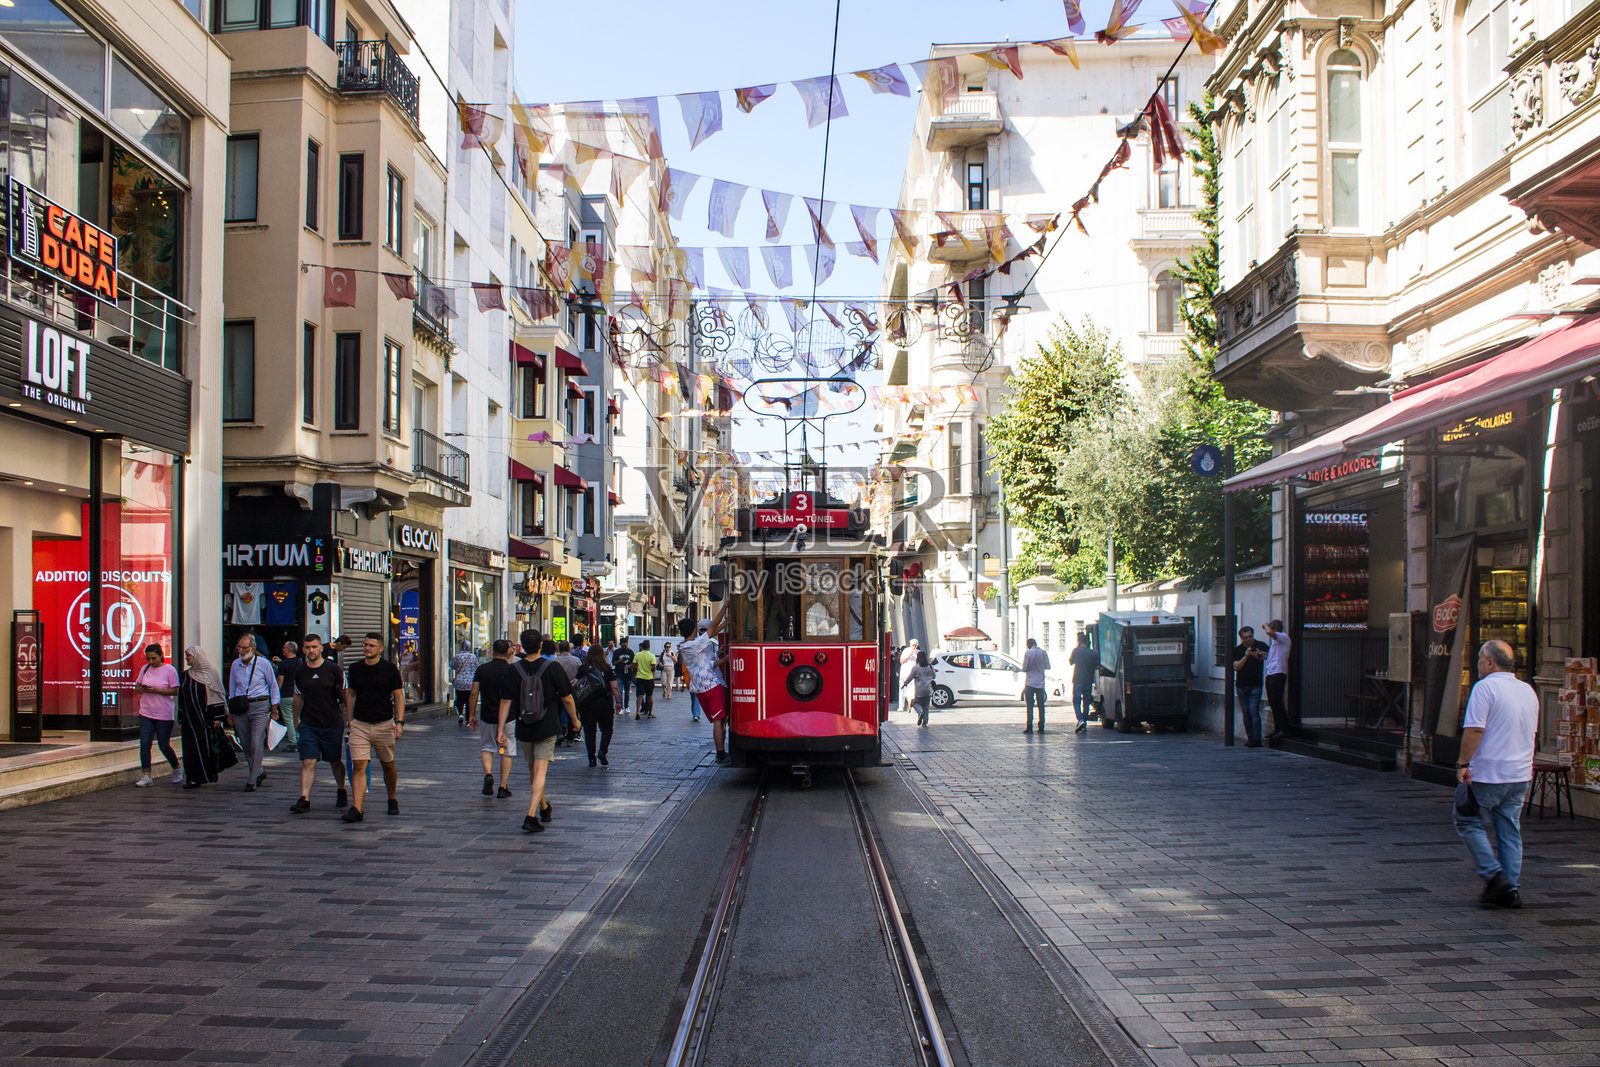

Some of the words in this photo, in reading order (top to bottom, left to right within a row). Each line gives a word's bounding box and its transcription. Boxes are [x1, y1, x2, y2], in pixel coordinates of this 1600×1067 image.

[48, 204, 114, 263] CAFE
[42, 233, 118, 299] DUBAI
[28, 319, 90, 400] LOFT
[24, 384, 42, 400] THE
[47, 392, 86, 415] ORIGINAL
[795, 494, 808, 511] 3
[761, 514, 794, 523] TAKSİM
[806, 514, 835, 523] TÜNEL
[1305, 513, 1368, 527] KOKOREÇ
[402, 525, 440, 552] GLOCAL
[315, 538, 324, 571] KIDS
[349, 547, 389, 575] TSHIRTIUM
[864, 658, 875, 672] 410
